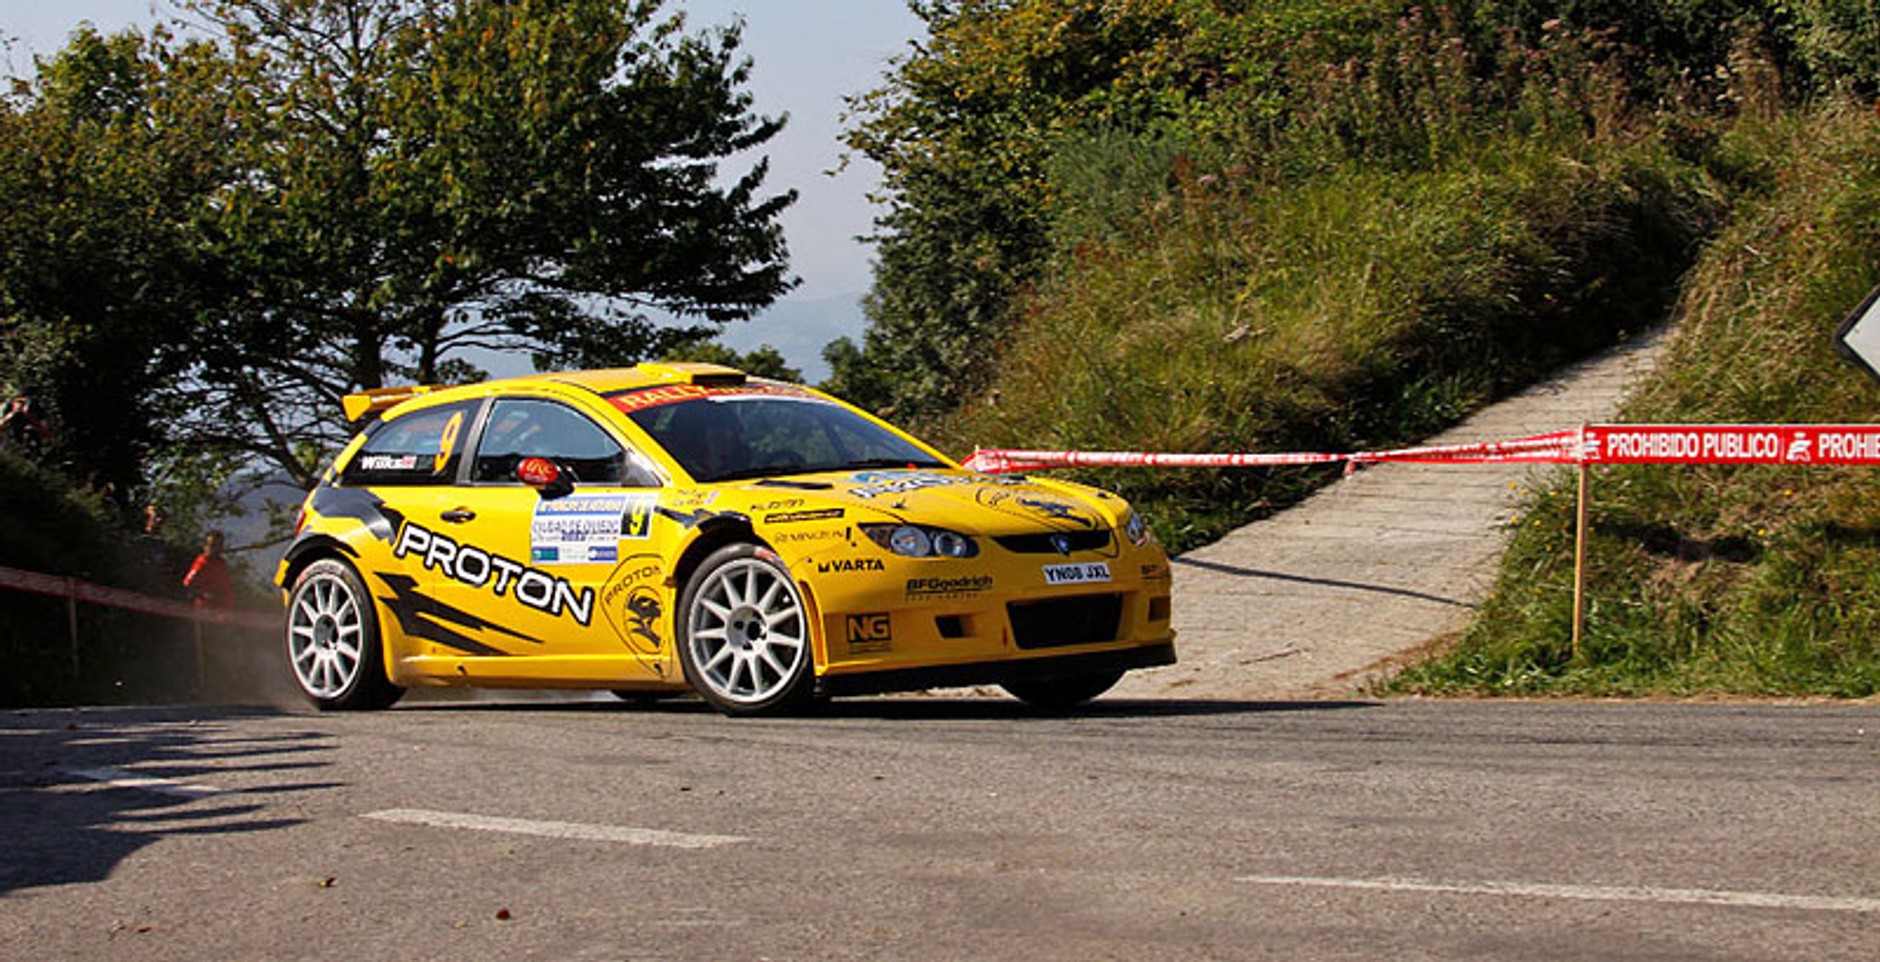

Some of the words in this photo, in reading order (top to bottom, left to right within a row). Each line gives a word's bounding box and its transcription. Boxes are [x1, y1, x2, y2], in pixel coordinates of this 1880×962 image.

[434, 411, 463, 472] 9
[1607, 432, 1699, 458] PROHIBIDO
[1702, 432, 1778, 458] PUBLICO
[361, 455, 404, 470] Wilks
[629, 501, 645, 536] 9
[397, 523, 595, 625] PROTON
[832, 559, 885, 572] VARTA
[1044, 566, 1082, 582] YN08
[1086, 564, 1111, 579] JXL
[604, 565, 662, 605] PROTON
[906, 574, 993, 591] BFGoodrich
[848, 615, 890, 642] NG
